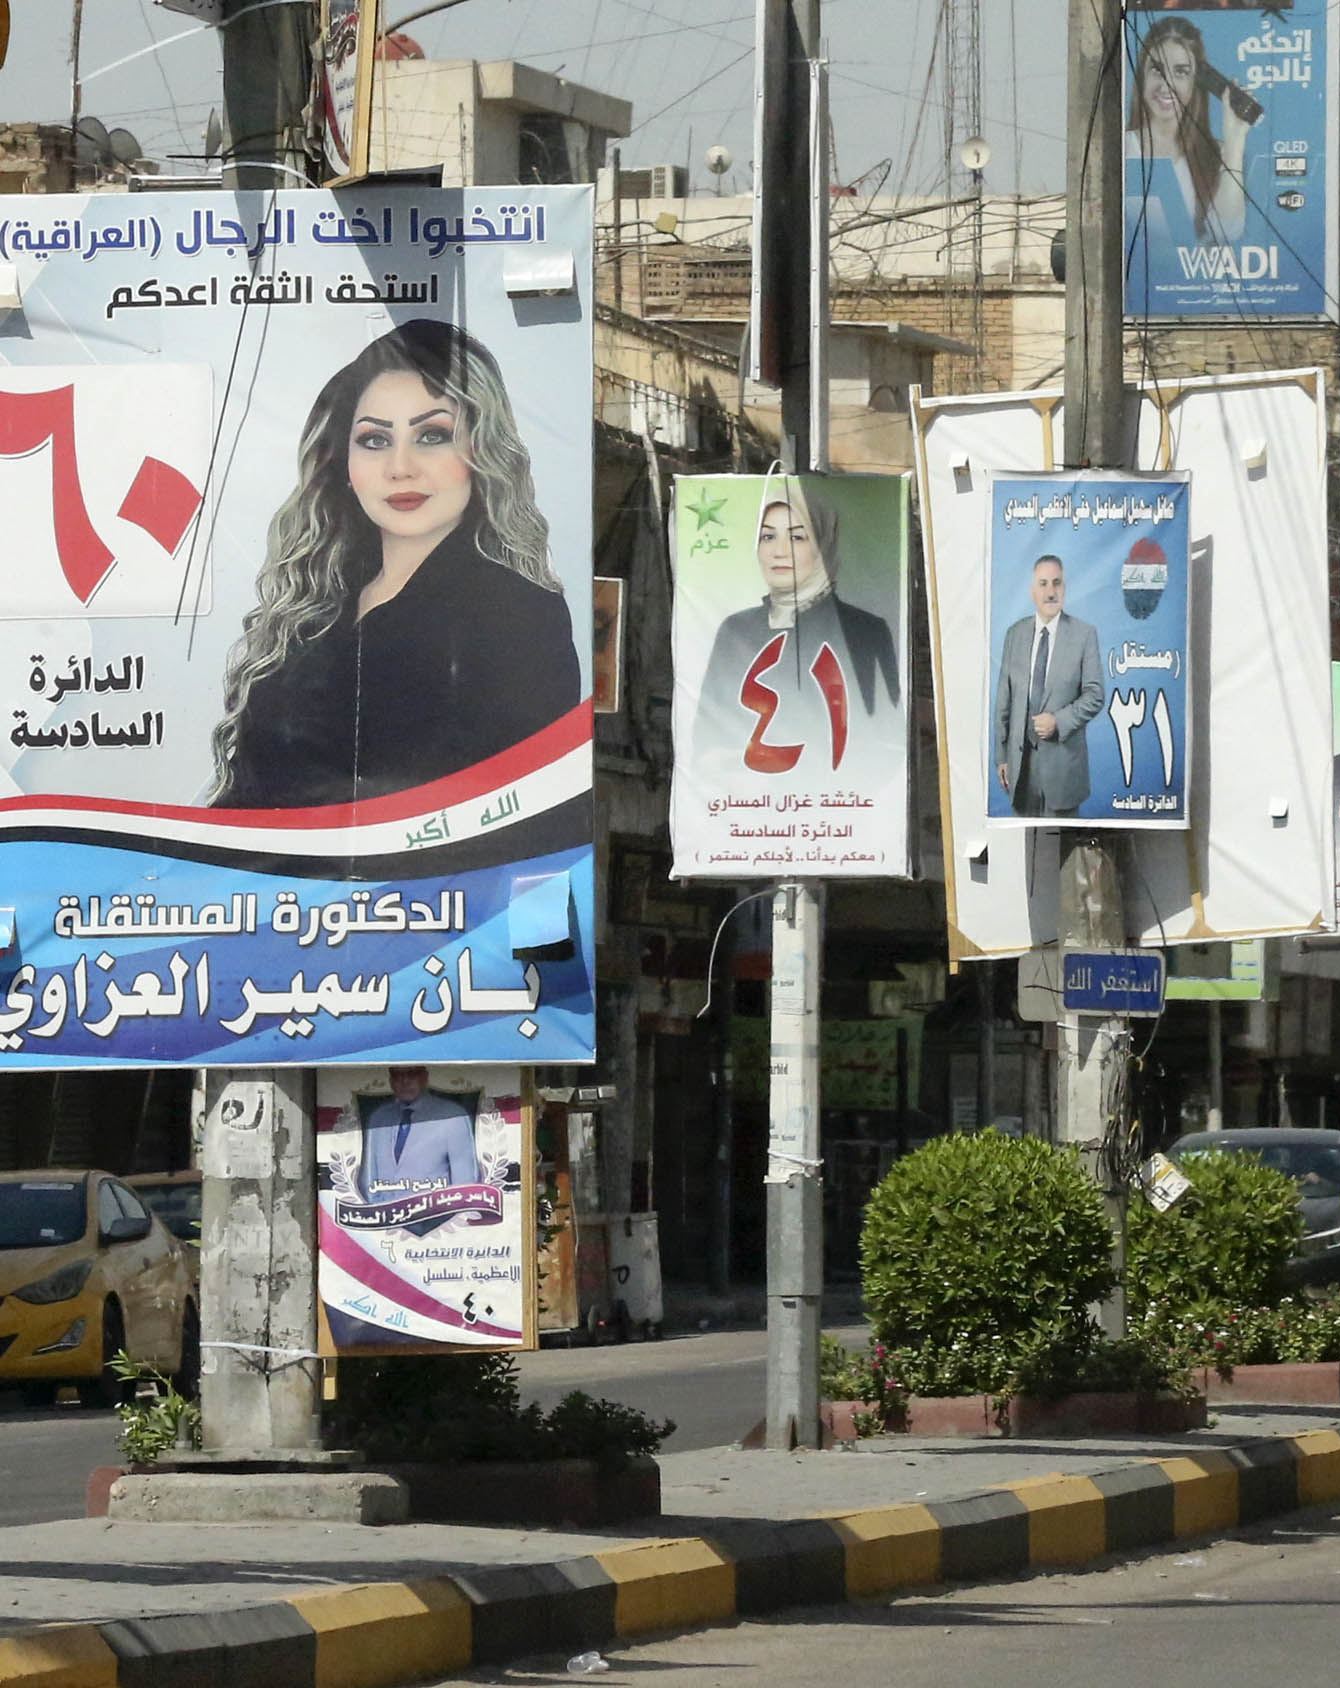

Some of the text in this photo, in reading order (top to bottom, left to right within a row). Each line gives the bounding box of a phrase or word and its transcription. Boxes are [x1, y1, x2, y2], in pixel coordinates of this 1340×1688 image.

[1245, 58, 1312, 89] بالجو
[1273, 141, 1308, 153] QLED
[175, 208, 295, 261] الرجال
[312, 206, 391, 247] اخت
[409, 205, 546, 259] انتخبوا
[1177, 246, 1278, 279] WADI
[106, 272, 438, 318] استحق الثقة اعدكم
[690, 533, 730, 557] عزم
[30, 654, 144, 703] الدائرة
[740, 631, 850, 774] ٤١
[9, 709, 164, 748] السادسة
[1108, 688, 1175, 787] ٣١
[479, 789, 520, 828] الله
[708, 791, 874, 817] عائشة غزال المساري
[730, 821, 853, 841] الدائرة السادسة
[708, 851, 749, 864] نستمر
[840, 851, 876, 866] معكم
[54, 889, 465, 947] الدكتورة المستقلة
[0, 947, 540, 1050] بان سمير العزاوي
[1099, 967, 1160, 999] استغفر
